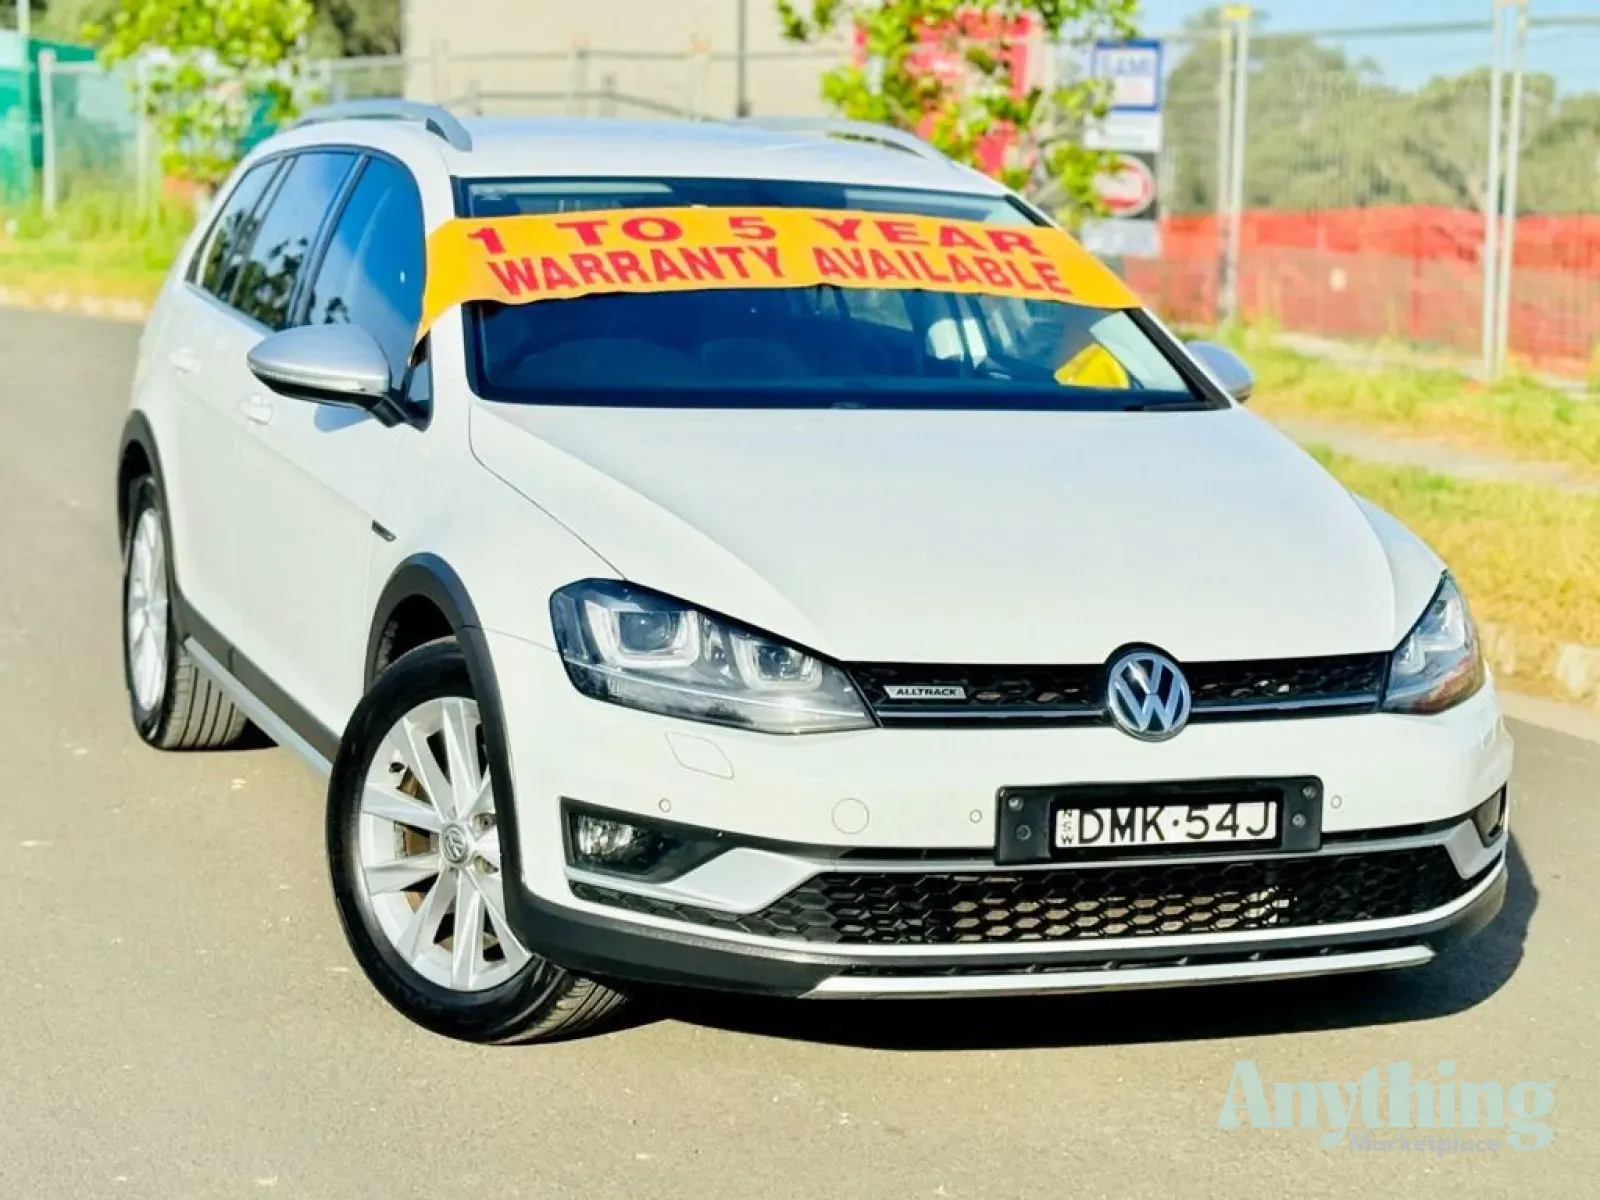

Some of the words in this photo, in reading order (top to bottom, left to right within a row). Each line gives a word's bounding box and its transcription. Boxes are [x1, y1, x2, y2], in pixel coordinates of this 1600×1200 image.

[467, 226, 506, 255] 1
[555, 216, 683, 247] TO
[728, 216, 777, 241] 5
[813, 216, 1048, 257] YEAR
[486, 245, 786, 297] WARRANTY
[812, 246, 1072, 296] AVAILABLE
[896, 687, 957, 696] ALLTRACK
